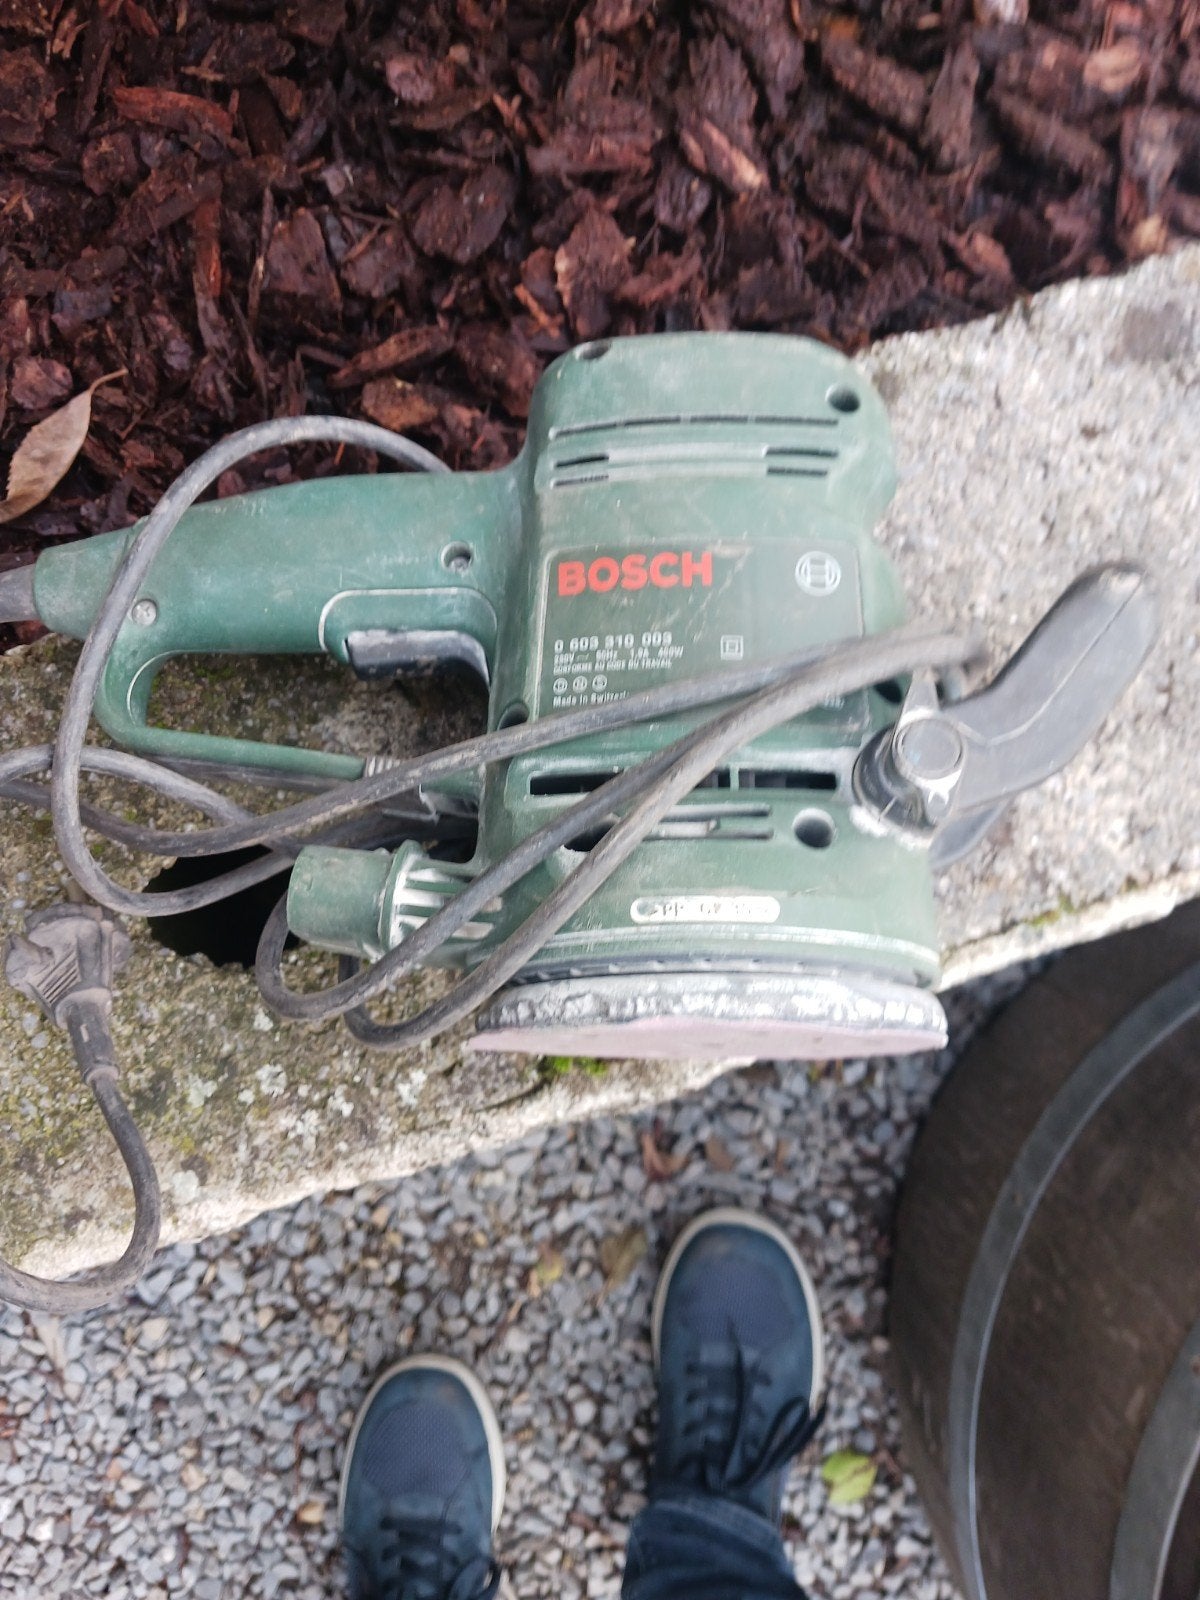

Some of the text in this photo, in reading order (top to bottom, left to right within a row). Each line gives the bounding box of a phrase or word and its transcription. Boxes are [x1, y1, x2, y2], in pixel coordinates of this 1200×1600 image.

[557, 552, 713, 597] BOSCH
[554, 639, 564, 653] 0
[553, 695, 577, 709] Made
